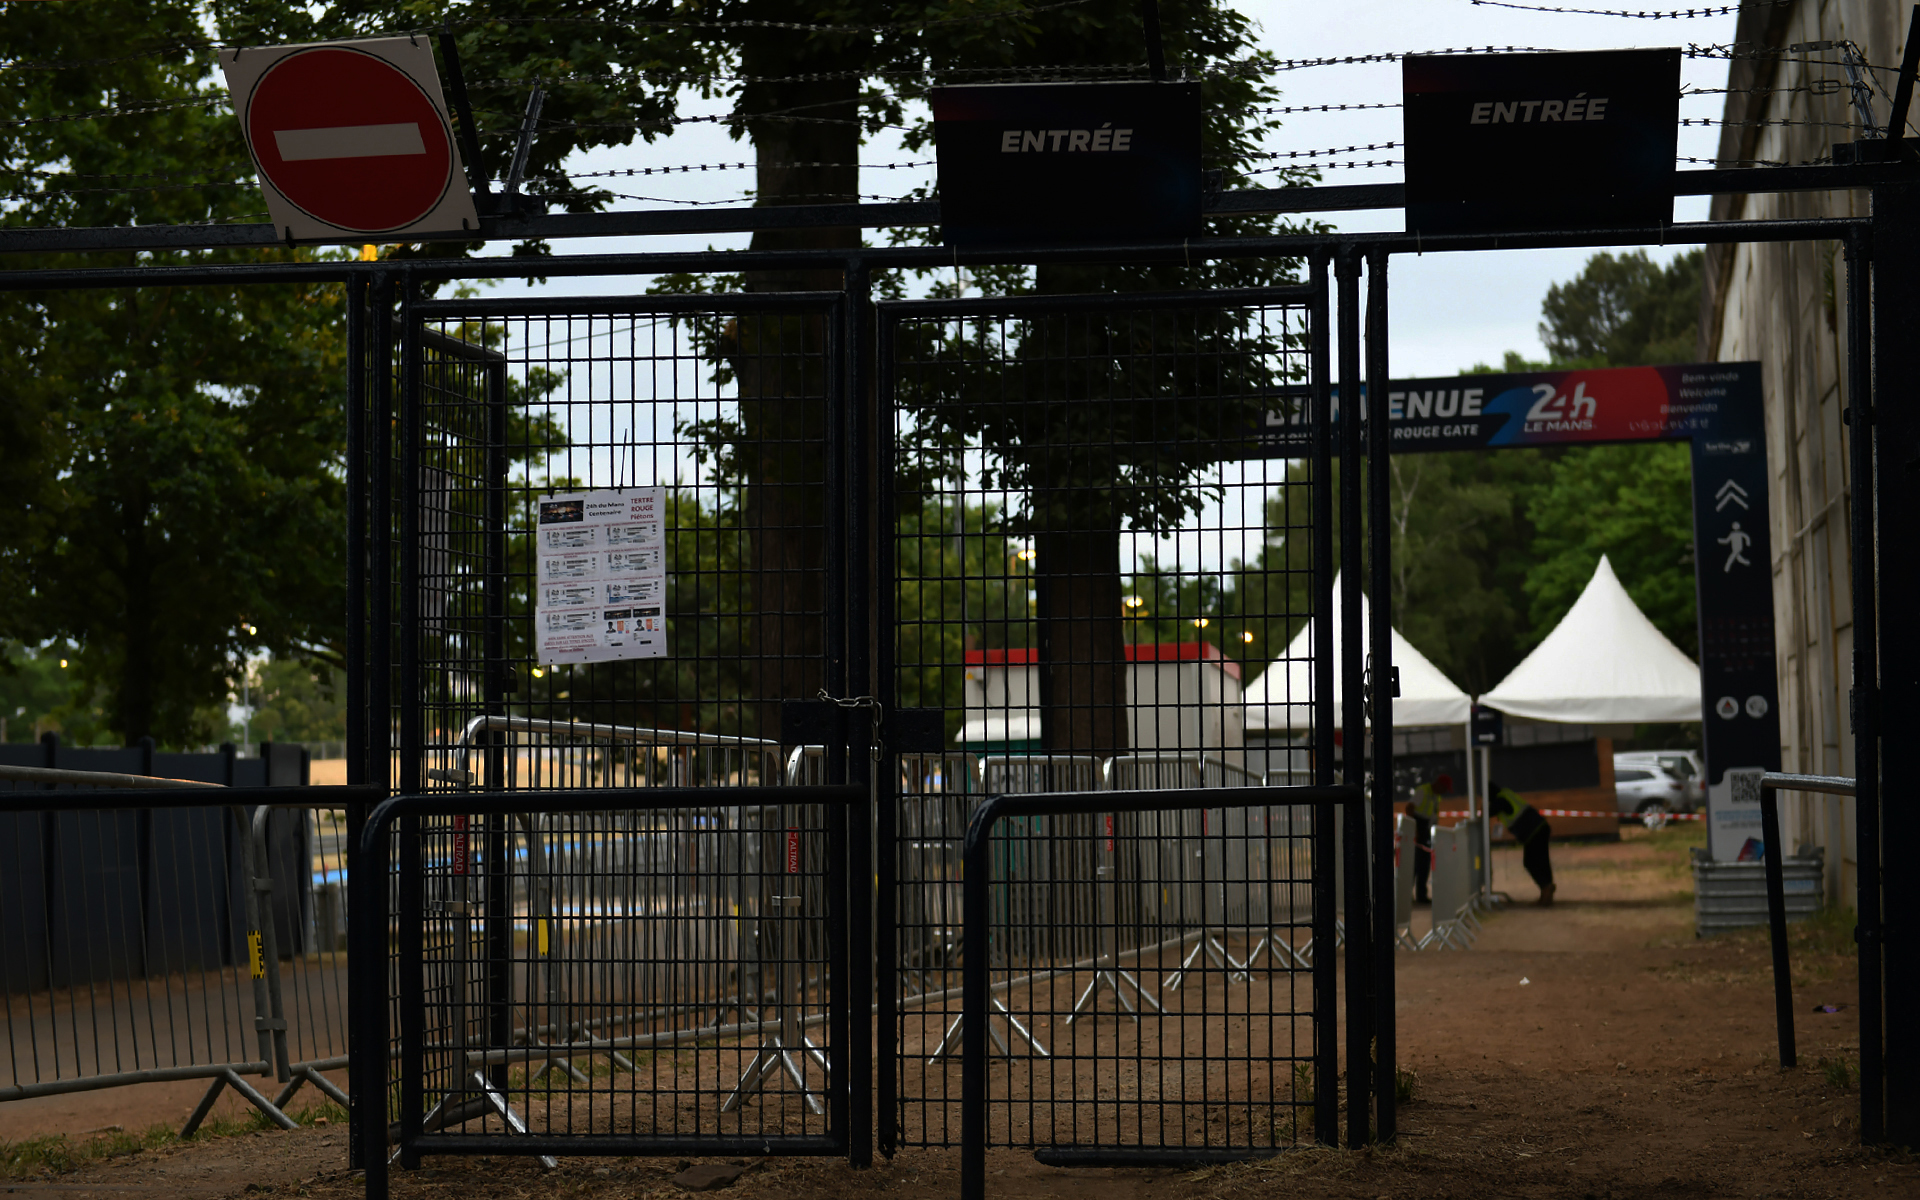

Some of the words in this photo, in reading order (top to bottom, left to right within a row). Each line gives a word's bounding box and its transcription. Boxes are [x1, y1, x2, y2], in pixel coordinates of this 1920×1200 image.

[1470, 91, 1609, 126] ENTRÉE
[1000, 121, 1134, 153] ENTRÉE
[1682, 371, 1739, 384] Bem-vindo
[1679, 387, 1726, 399] Welcome
[1526, 381, 1597, 421] 24h
[1660, 402, 1718, 415] Bienvenido
[1394, 426, 1440, 439] ROUGE
[1443, 424, 1479, 437] GATE
[1524, 422, 1542, 434] LE
[1546, 420, 1593, 432] MANS
[630, 504, 654, 512] ROUGE
[455, 833, 464, 872] ALTRAD
